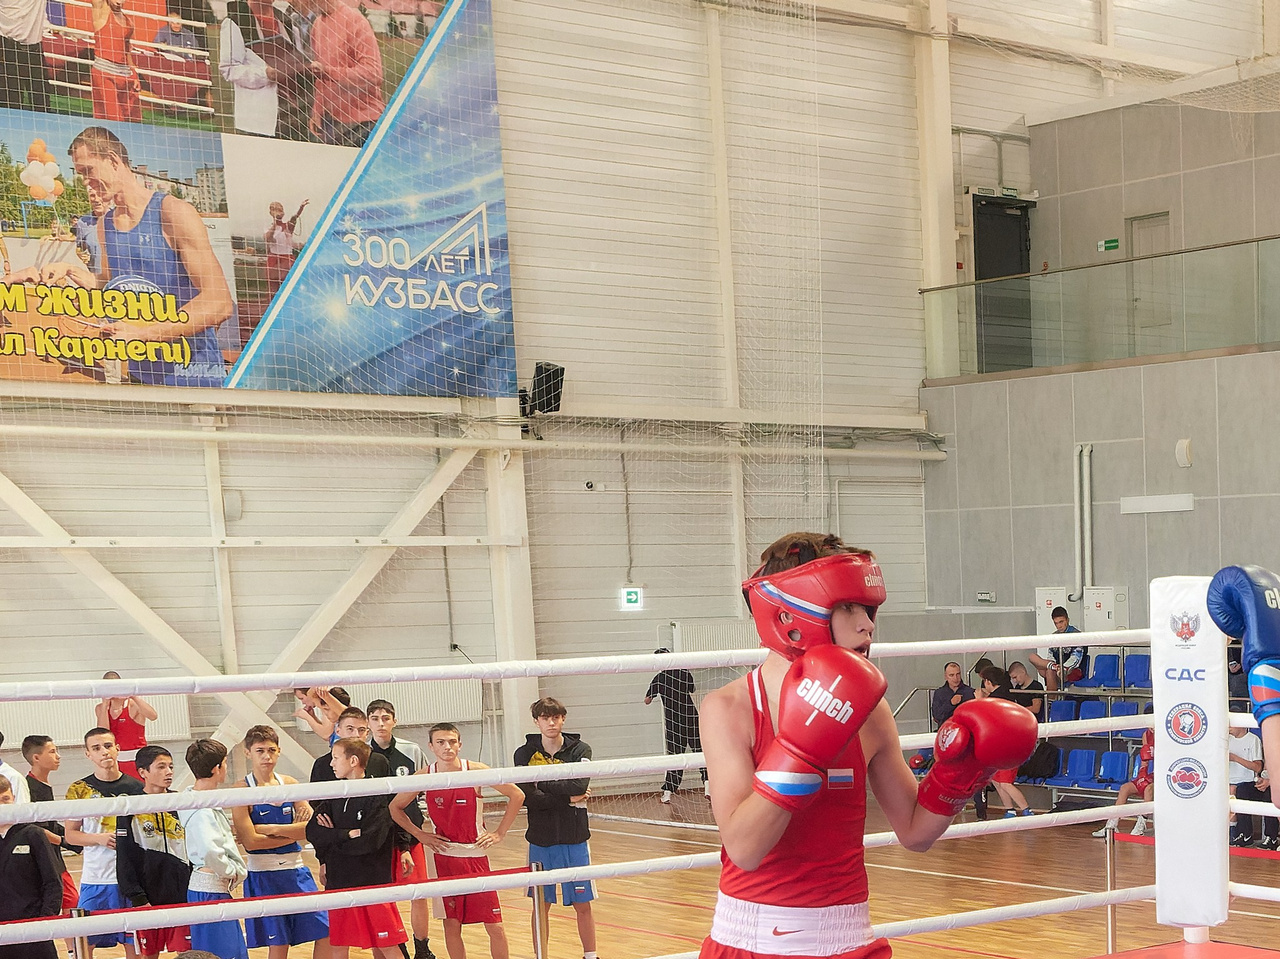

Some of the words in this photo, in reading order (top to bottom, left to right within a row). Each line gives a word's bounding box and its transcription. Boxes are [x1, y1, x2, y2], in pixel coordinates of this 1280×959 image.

[343, 233, 411, 271] 300
[36, 284, 189, 323] жизни.
[343, 273, 501, 314] КУЗБАСС
[31, 327, 192, 368] Карнеги)
[1165, 668, 1206, 681] СДС
[796, 677, 854, 724] clinch
